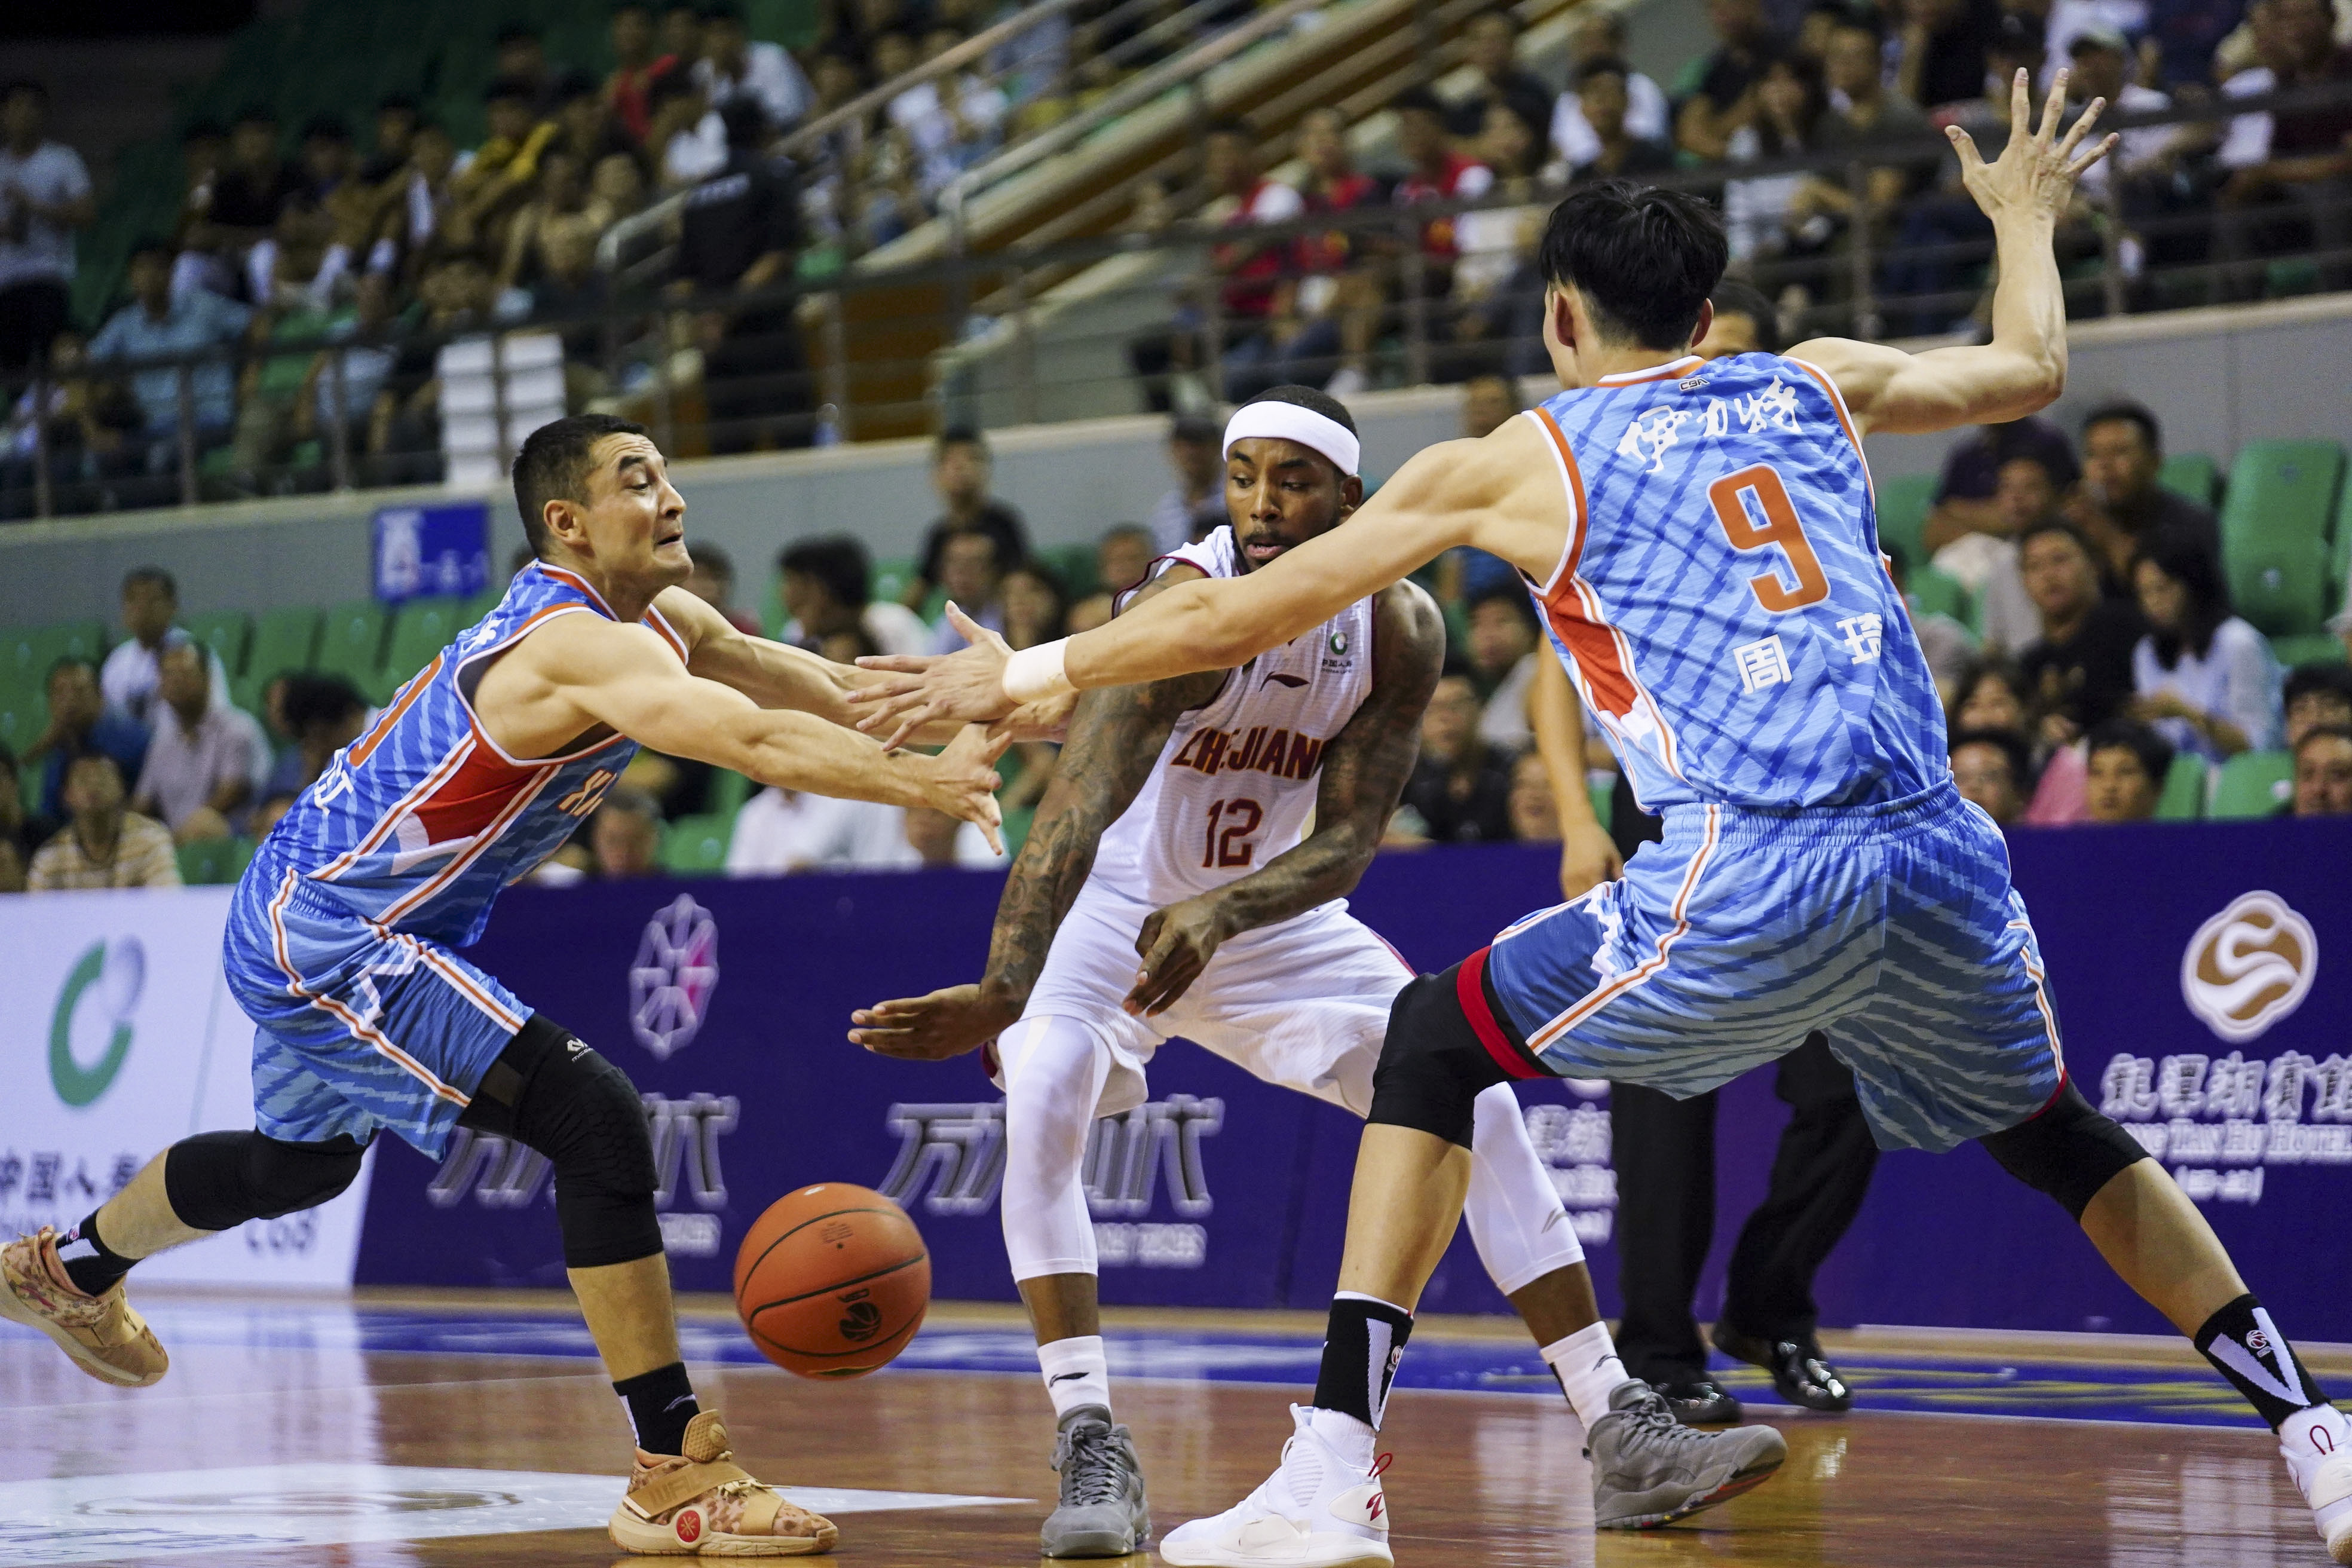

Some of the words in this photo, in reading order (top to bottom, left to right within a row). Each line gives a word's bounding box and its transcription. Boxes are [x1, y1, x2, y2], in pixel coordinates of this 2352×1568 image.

[1680, 378, 1710, 390] CBA
[1706, 463, 1831, 614] 9
[1171, 727, 1324, 780] ZHJIAN
[1202, 798, 1264, 869] 12
